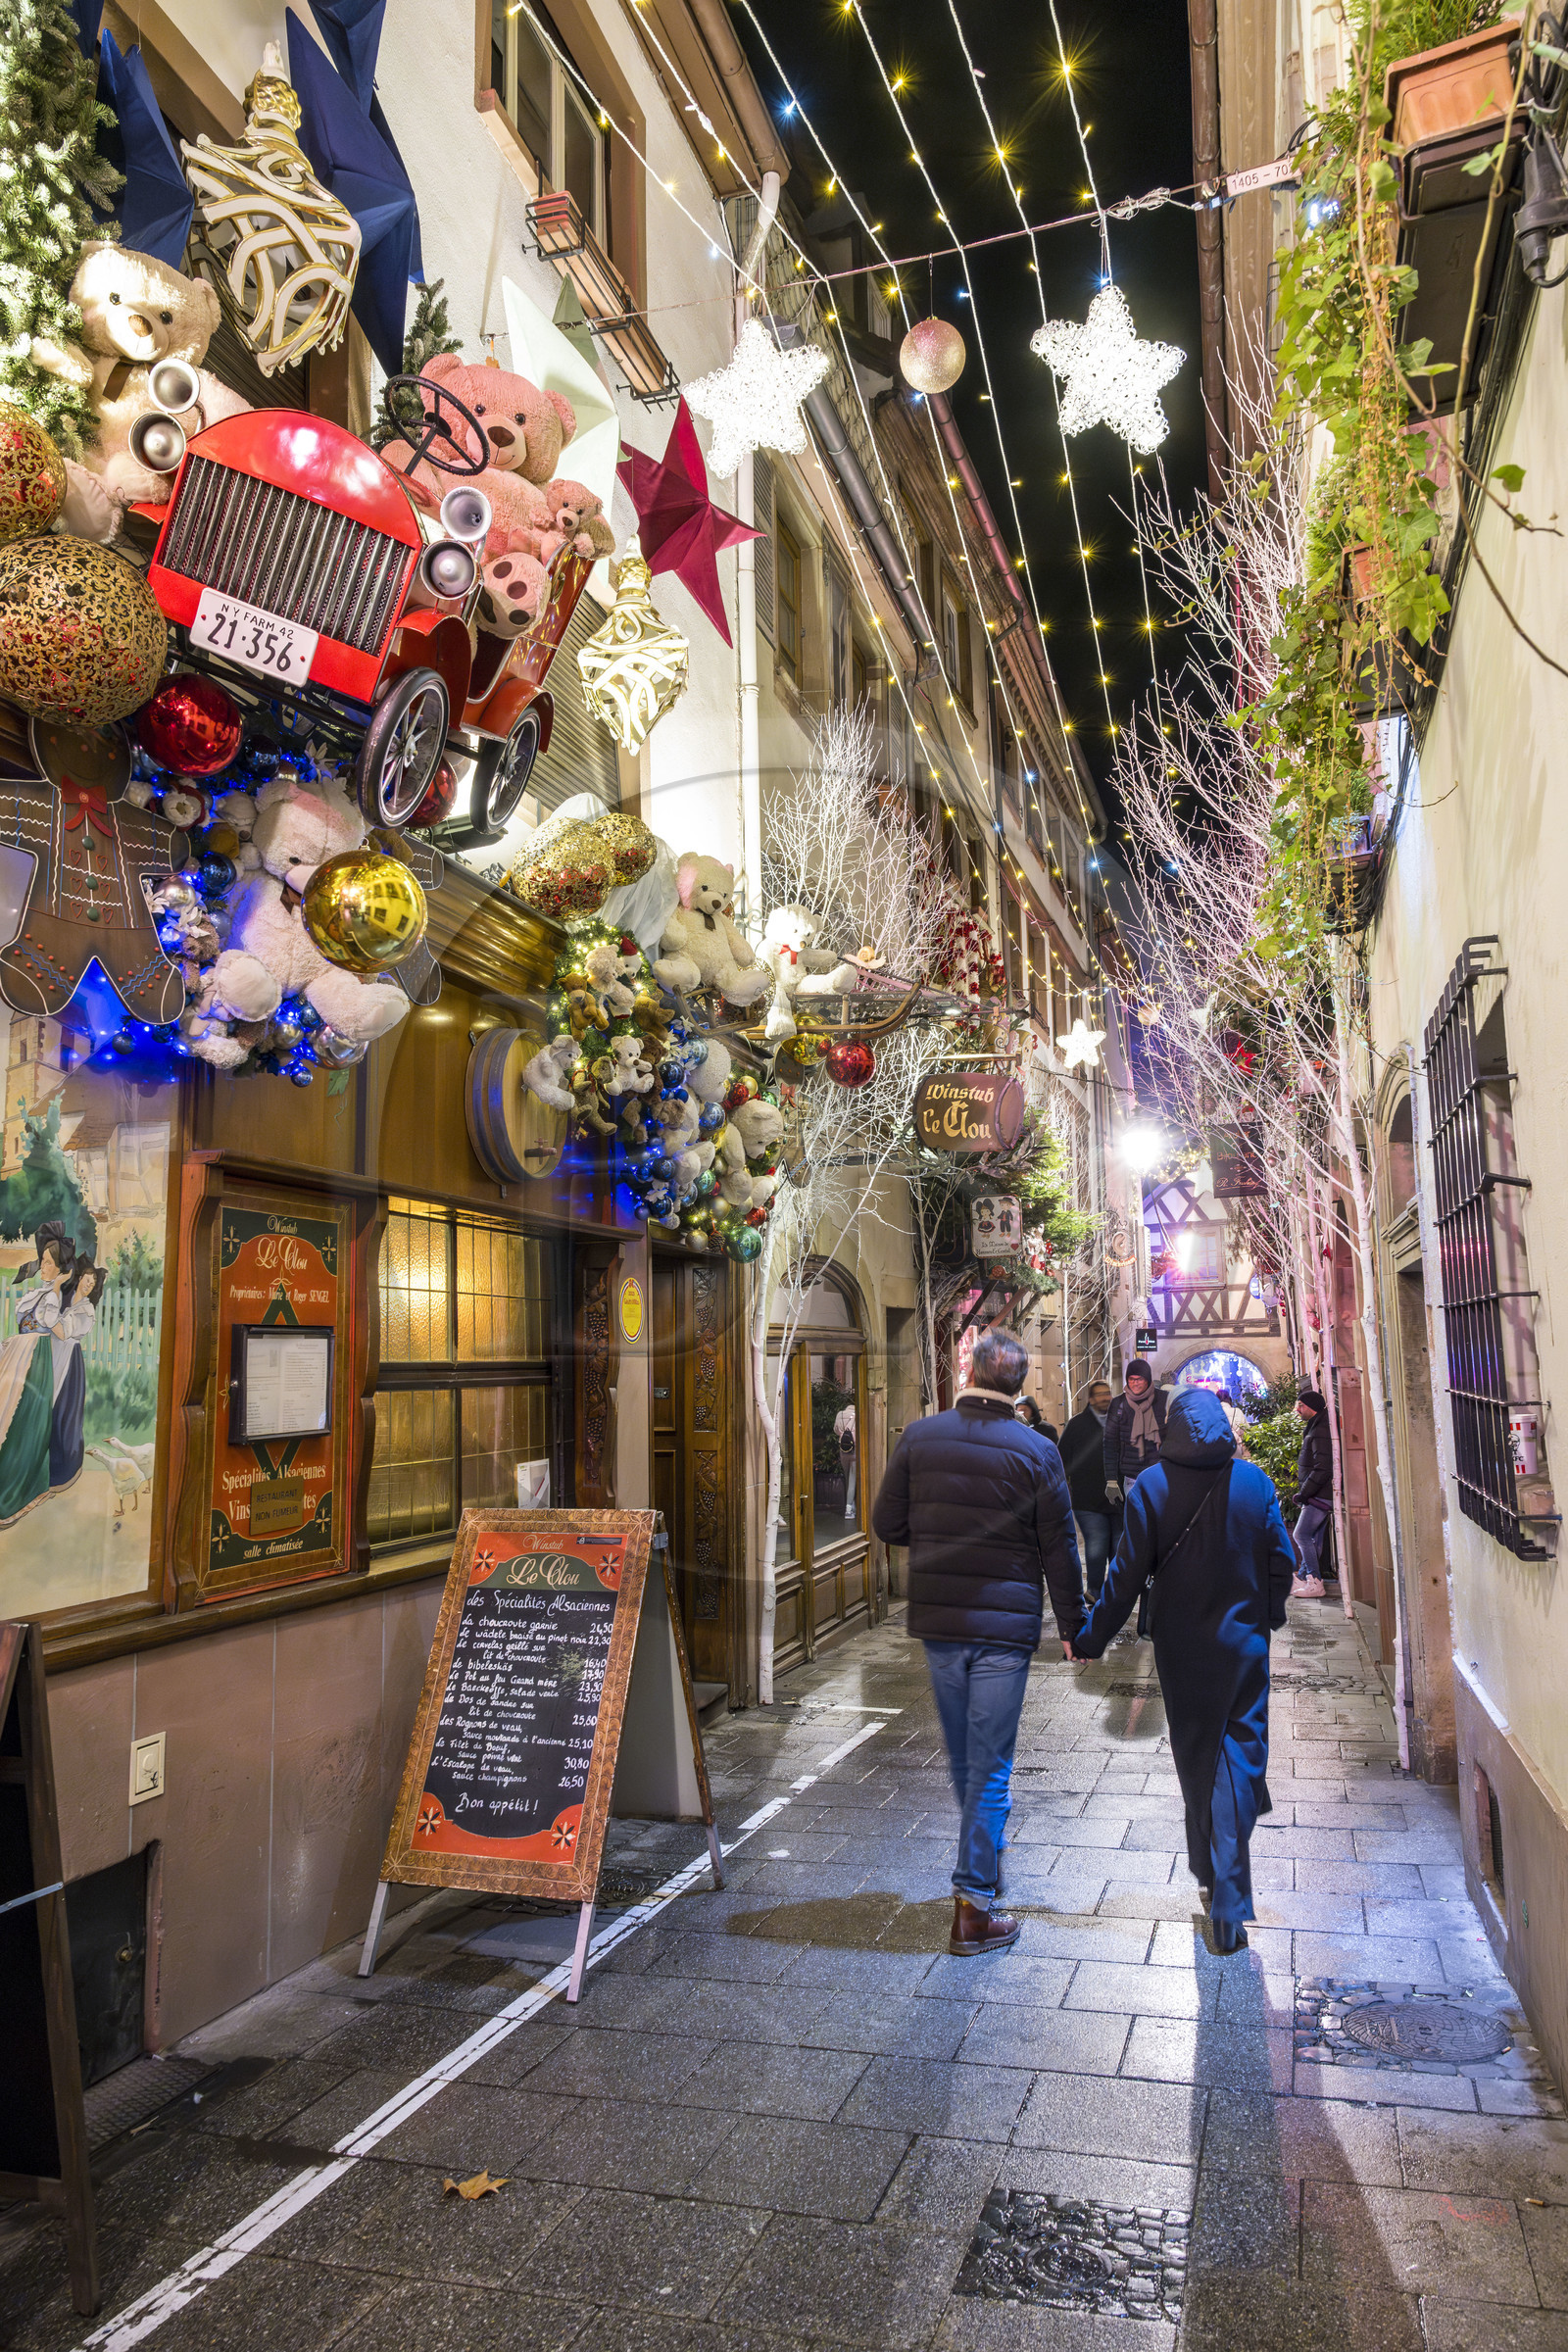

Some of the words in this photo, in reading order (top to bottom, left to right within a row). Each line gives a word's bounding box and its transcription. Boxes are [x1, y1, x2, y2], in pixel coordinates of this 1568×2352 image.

[1232, 174, 1258, 190] 1405
[243, 612, 274, 631] FARM
[279, 626, 294, 640] 42
[925, 1083, 994, 1103] Winstub
[923, 1108, 940, 1134] Le
[944, 1100, 992, 1139] Clou
[268, 1215, 298, 1235] Winstub
[256, 1237, 278, 1269] Le
[278, 1237, 307, 1276] Clou
[269, 1286, 283, 1300] Marie
[285, 1290, 291, 1300] et
[293, 1289, 307, 1303] Roger
[310, 1290, 329, 1303] SENGEL
[221, 1467, 270, 1494] Spécialités
[277, 1462, 326, 1480] Alsaciennes
[257, 1490, 298, 1502] RESTAURANT
[229, 1499, 251, 1521] Vins
[256, 1511, 270, 1521] NON
[272, 1506, 298, 1517] FUMEUR
[243, 1544, 262, 1559] salle
[266, 1537, 304, 1555] climatisée
[522, 1535, 564, 1550] Winstub
[506, 1556, 538, 1585] Le
[539, 1554, 579, 1591] Clou
[494, 1590, 546, 1614] Spécialités
[547, 1593, 611, 1617] Alsaciennes
[479, 1615, 526, 1629] choucroute
[528, 1621, 558, 1635] garnie
[590, 1623, 613, 1636] 24,50
[472, 1641, 503, 1650] cervelas
[505, 1642, 529, 1655] grillé
[548, 1634, 567, 1643] pinot
[588, 1635, 612, 1646] 22,30
[467, 1658, 513, 1672] bibeleskäs
[496, 1651, 505, 1660] de
[507, 1652, 547, 1664] choucroute
[584, 1658, 608, 1669] 16,40
[465, 1671, 476, 1681] Pot
[492, 1674, 506, 1688] feu
[511, 1676, 534, 1686] Grand
[578, 1682, 603, 1693] 23,90
[459, 1693, 474, 1703] Dos
[490, 1698, 517, 1708] sandre
[510, 1687, 535, 1697] salade
[577, 1692, 601, 1704] 25,90
[456, 1716, 487, 1732] Rognons
[489, 1720, 498, 1729] de
[468, 1705, 480, 1715] lit
[497, 1709, 536, 1720] choucroute
[572, 1714, 598, 1727] 25,80
[450, 1740, 468, 1748] Filet
[463, 1731, 482, 1740] sauce
[485, 1733, 519, 1742] moutarde
[531, 1737, 565, 1746] l'ancienne
[568, 1739, 593, 1750] 25,10
[480, 1762, 490, 1771] de
[481, 1752, 504, 1763] poivre
[564, 1757, 590, 1770] 30,80
[452, 1771, 474, 1781] sauce
[478, 1773, 527, 1787] champignons
[558, 1776, 583, 1788] 26,50
[455, 1791, 484, 1813] Bon
[489, 1798, 529, 1815] appétit
